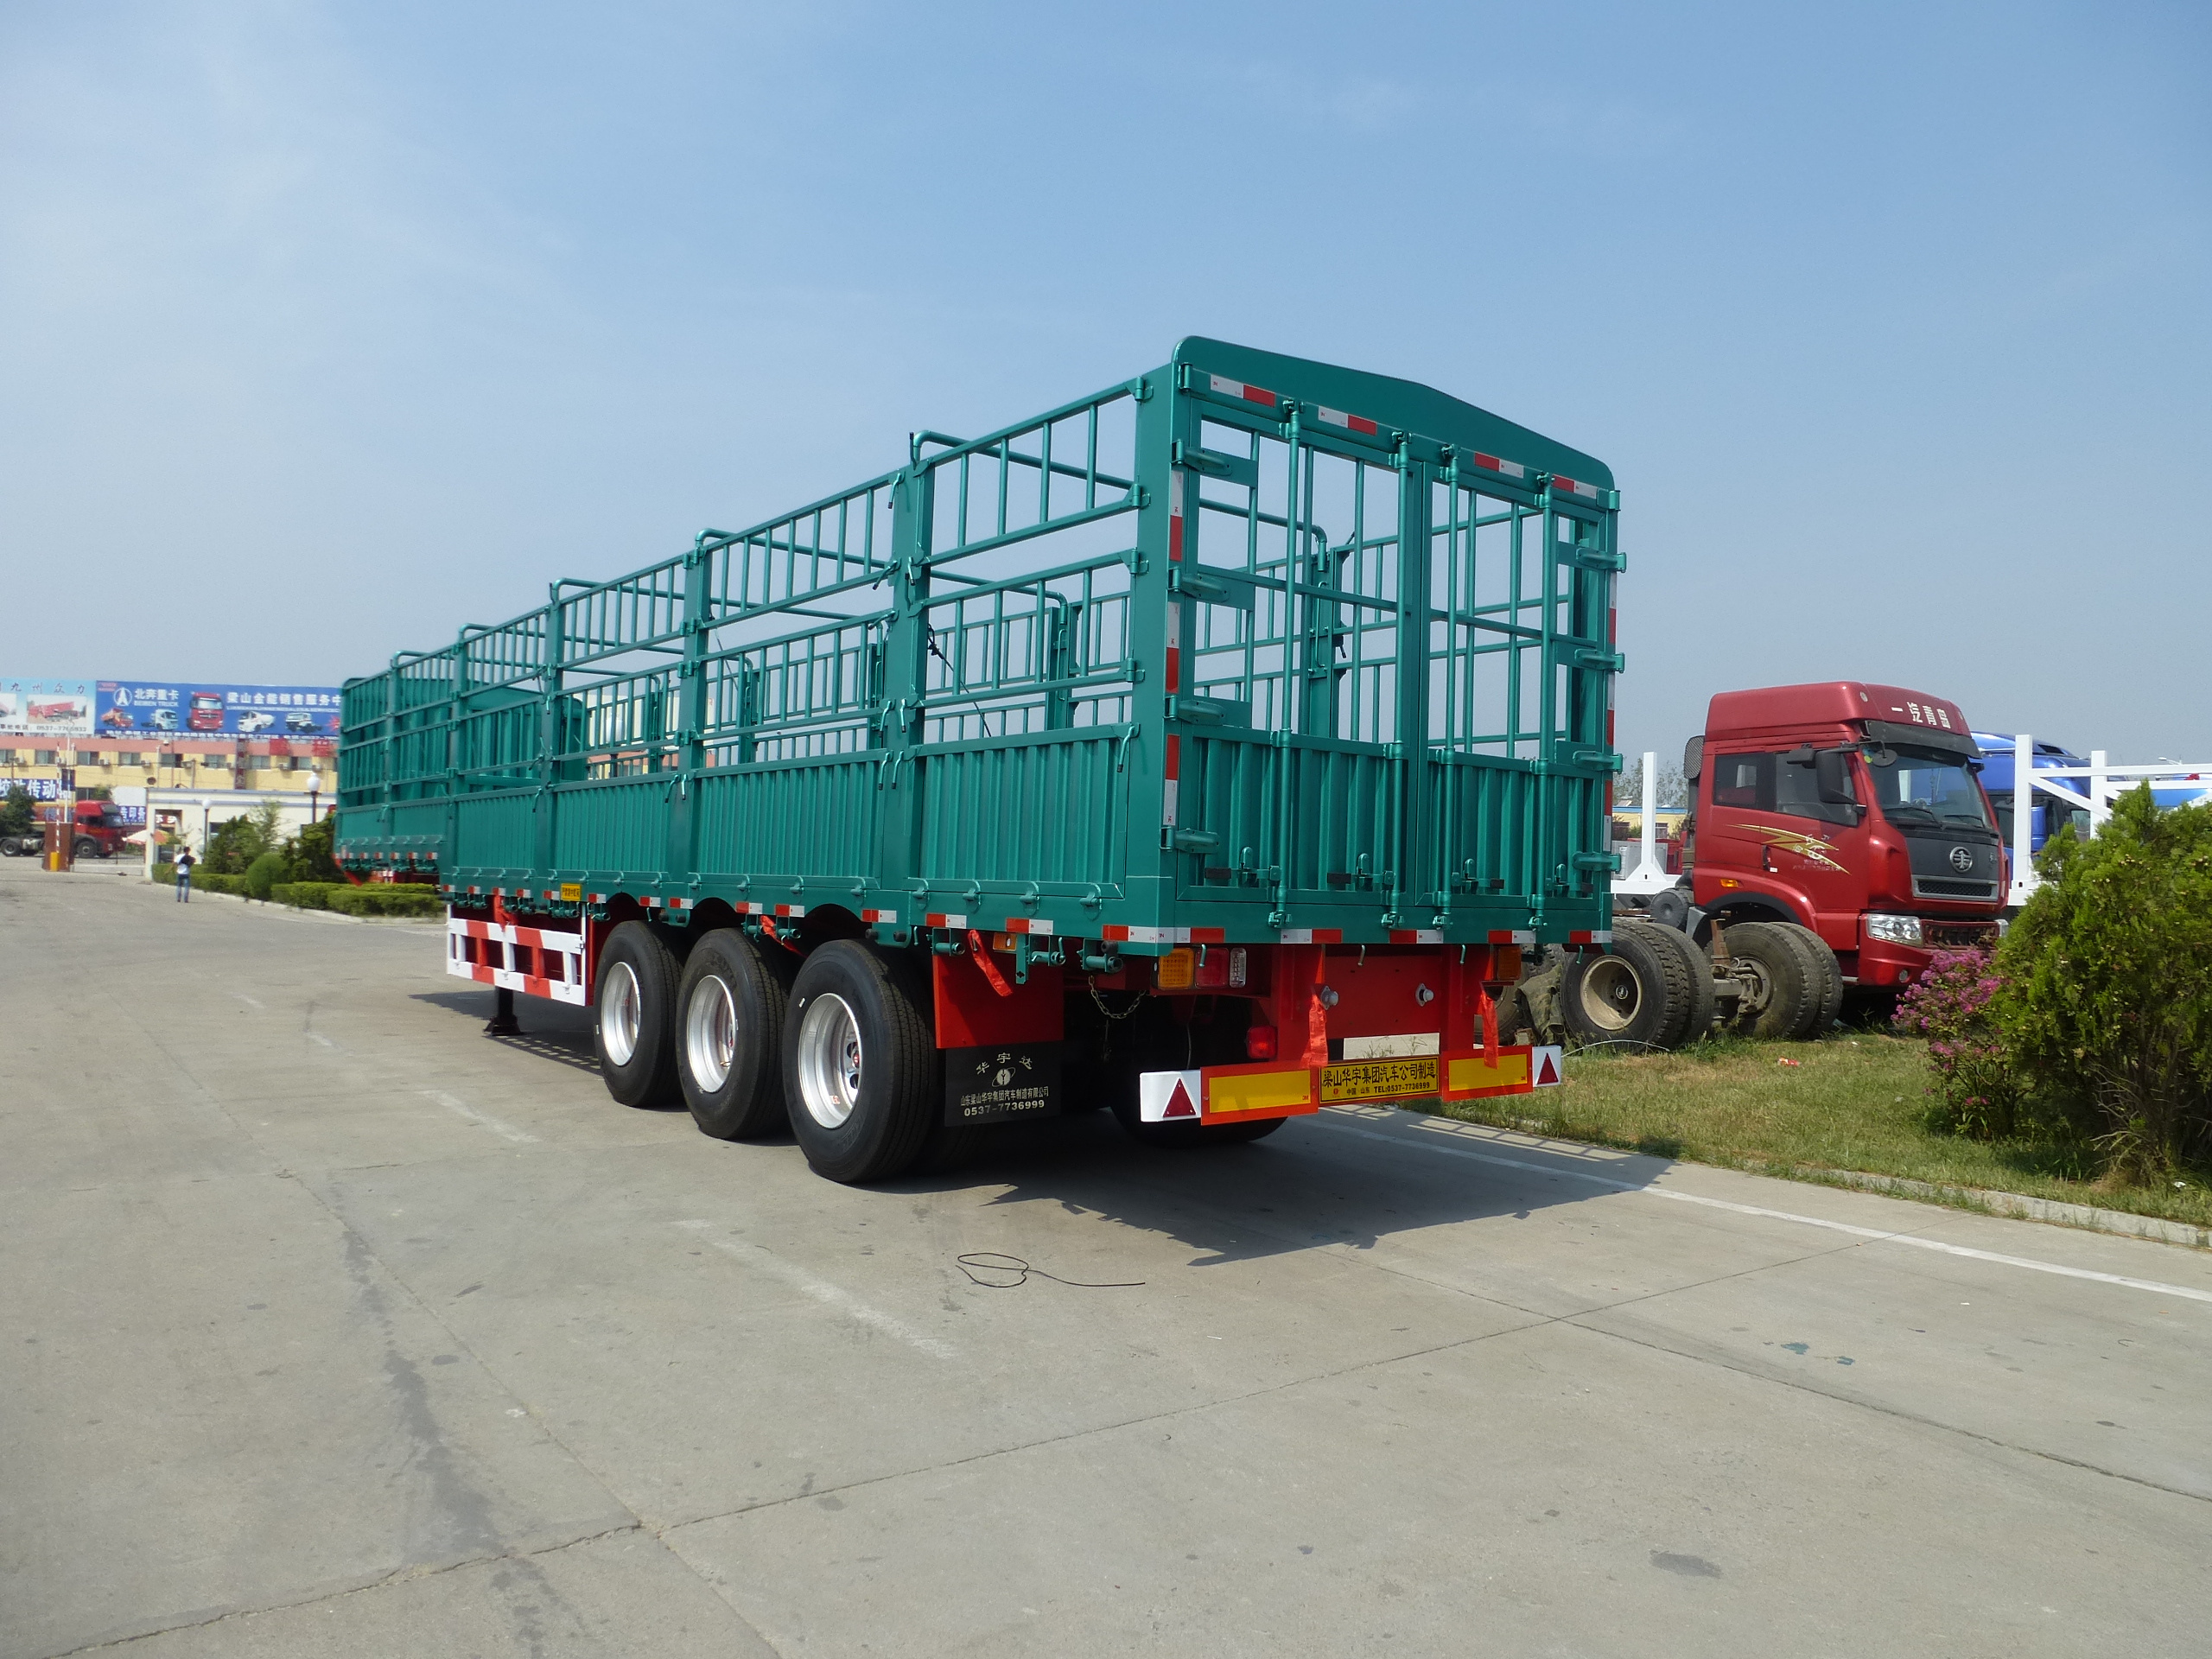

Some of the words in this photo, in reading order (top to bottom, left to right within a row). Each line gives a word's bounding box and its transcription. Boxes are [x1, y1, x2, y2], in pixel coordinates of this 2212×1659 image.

[0, 682, 85, 694] 九州众力
[134, 688, 179, 701] 北奔重卡
[976, 1052, 1033, 1075] 华宇达
[1323, 1061, 1436, 1088] 梁山华宇集团汽车公司制造
[963, 1099, 1046, 1116] 0537-7736999
